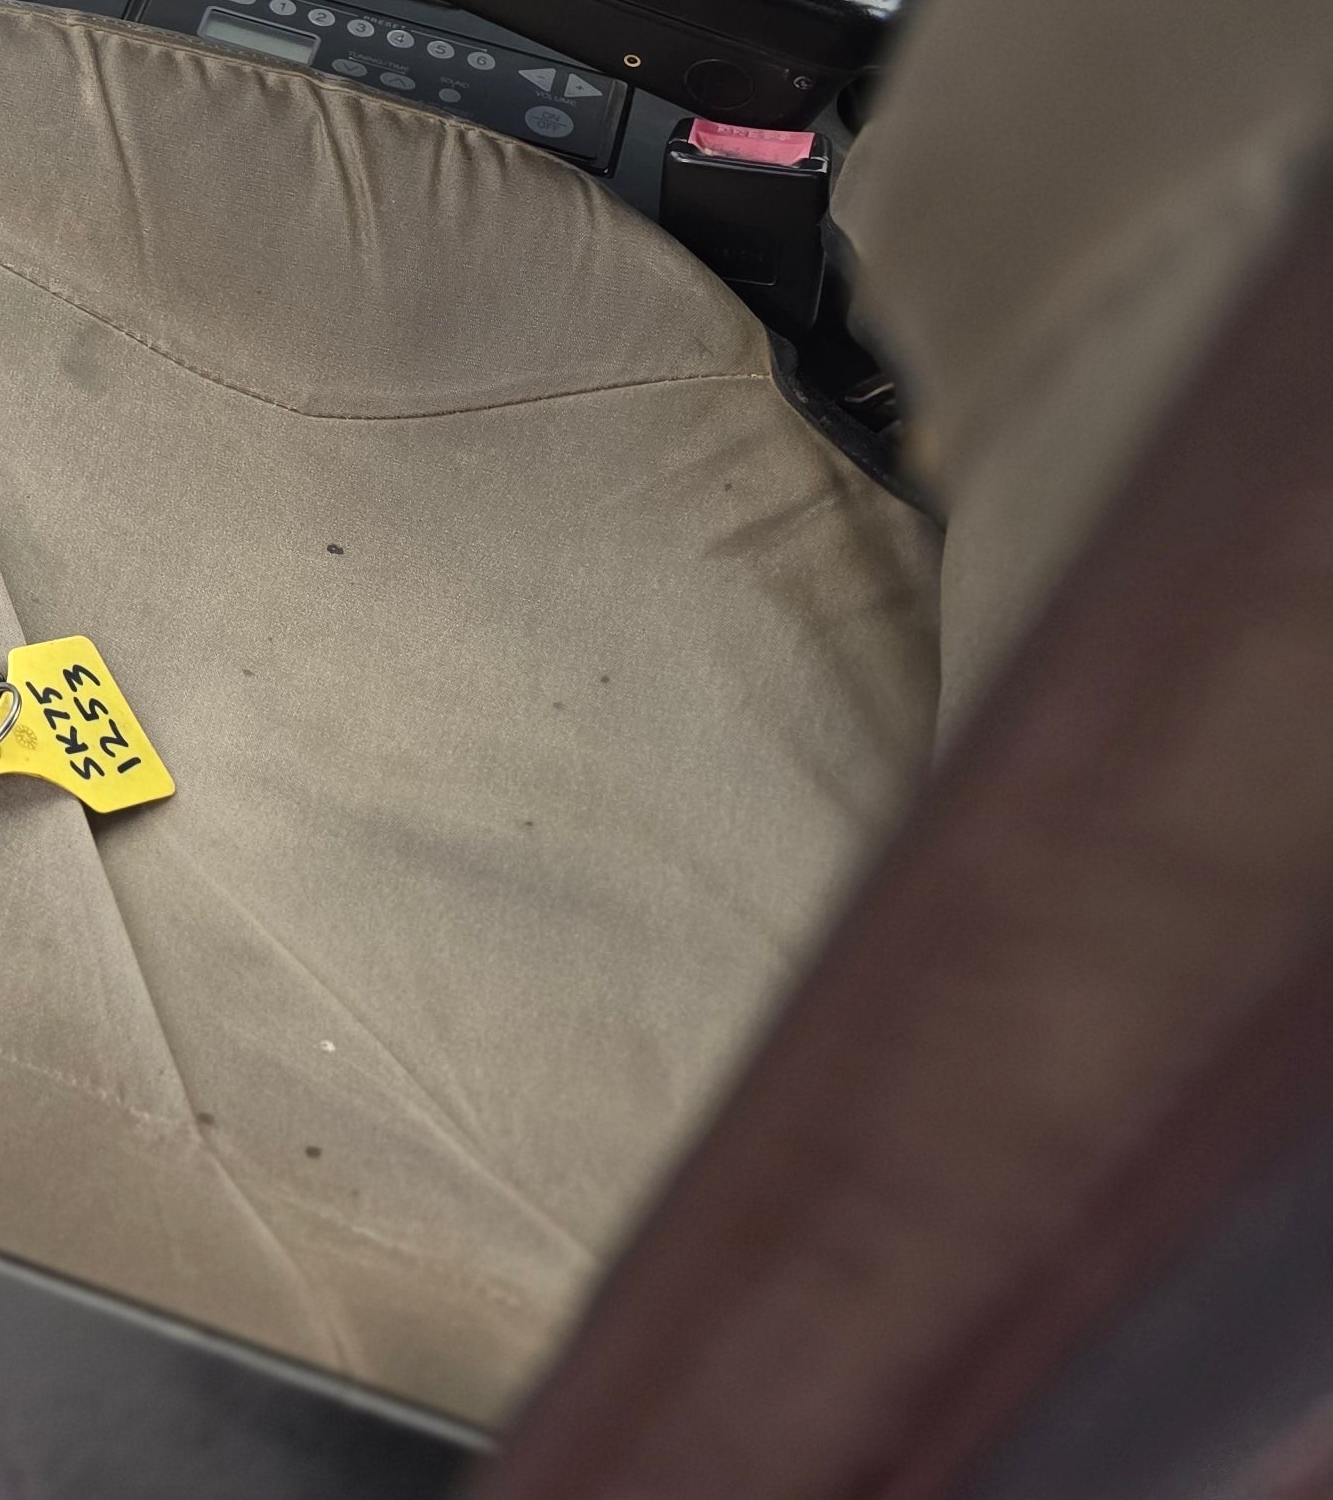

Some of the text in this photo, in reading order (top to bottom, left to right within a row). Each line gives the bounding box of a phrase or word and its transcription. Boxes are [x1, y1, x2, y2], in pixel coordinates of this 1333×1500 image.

[315, 12, 326, 21] 2
[363, 15, 406, 30] PRESET
[356, 23, 366, 33] 3
[394, 34, 405, 43] 4
[436, 45, 446, 55] 5
[477, 56, 487, 66] 6
[535, 90, 576, 106] VOLUME
[542, 111, 560, 121] ON
[536, 119, 559, 132] OFF
[62, 663, 142, 775] 1253
[26, 681, 105, 781] SK75
